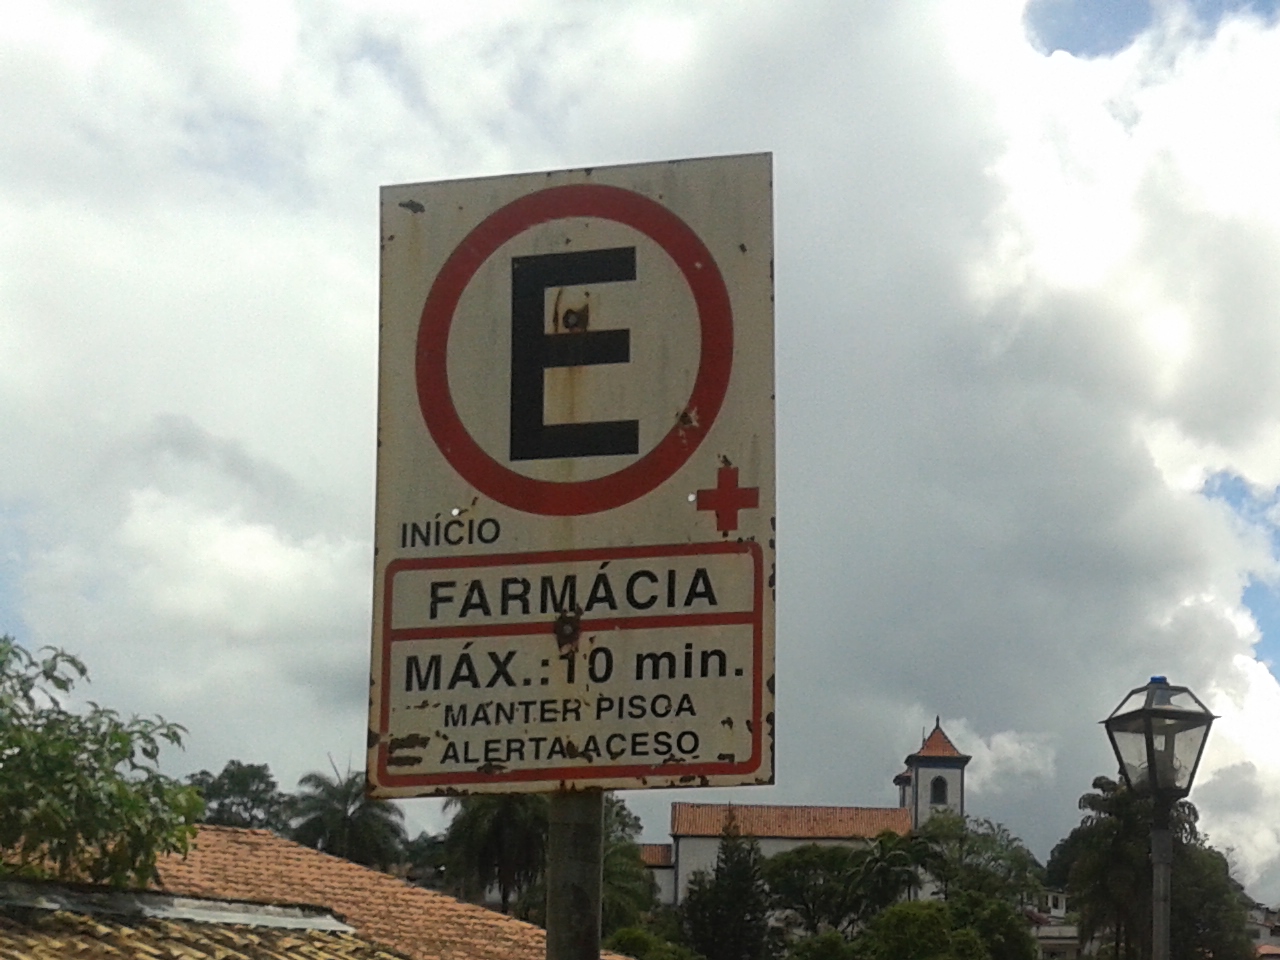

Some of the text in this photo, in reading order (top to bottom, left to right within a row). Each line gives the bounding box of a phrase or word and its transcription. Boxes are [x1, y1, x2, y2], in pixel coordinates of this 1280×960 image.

[510, 246, 639, 461] E
[401, 513, 500, 548] INÍCIO
[429, 562, 718, 620] FARMÁCIA
[635, 643, 744, 680] min.
[444, 700, 581, 727] MANTER
[440, 730, 700, 765] ALERTA ACESO
